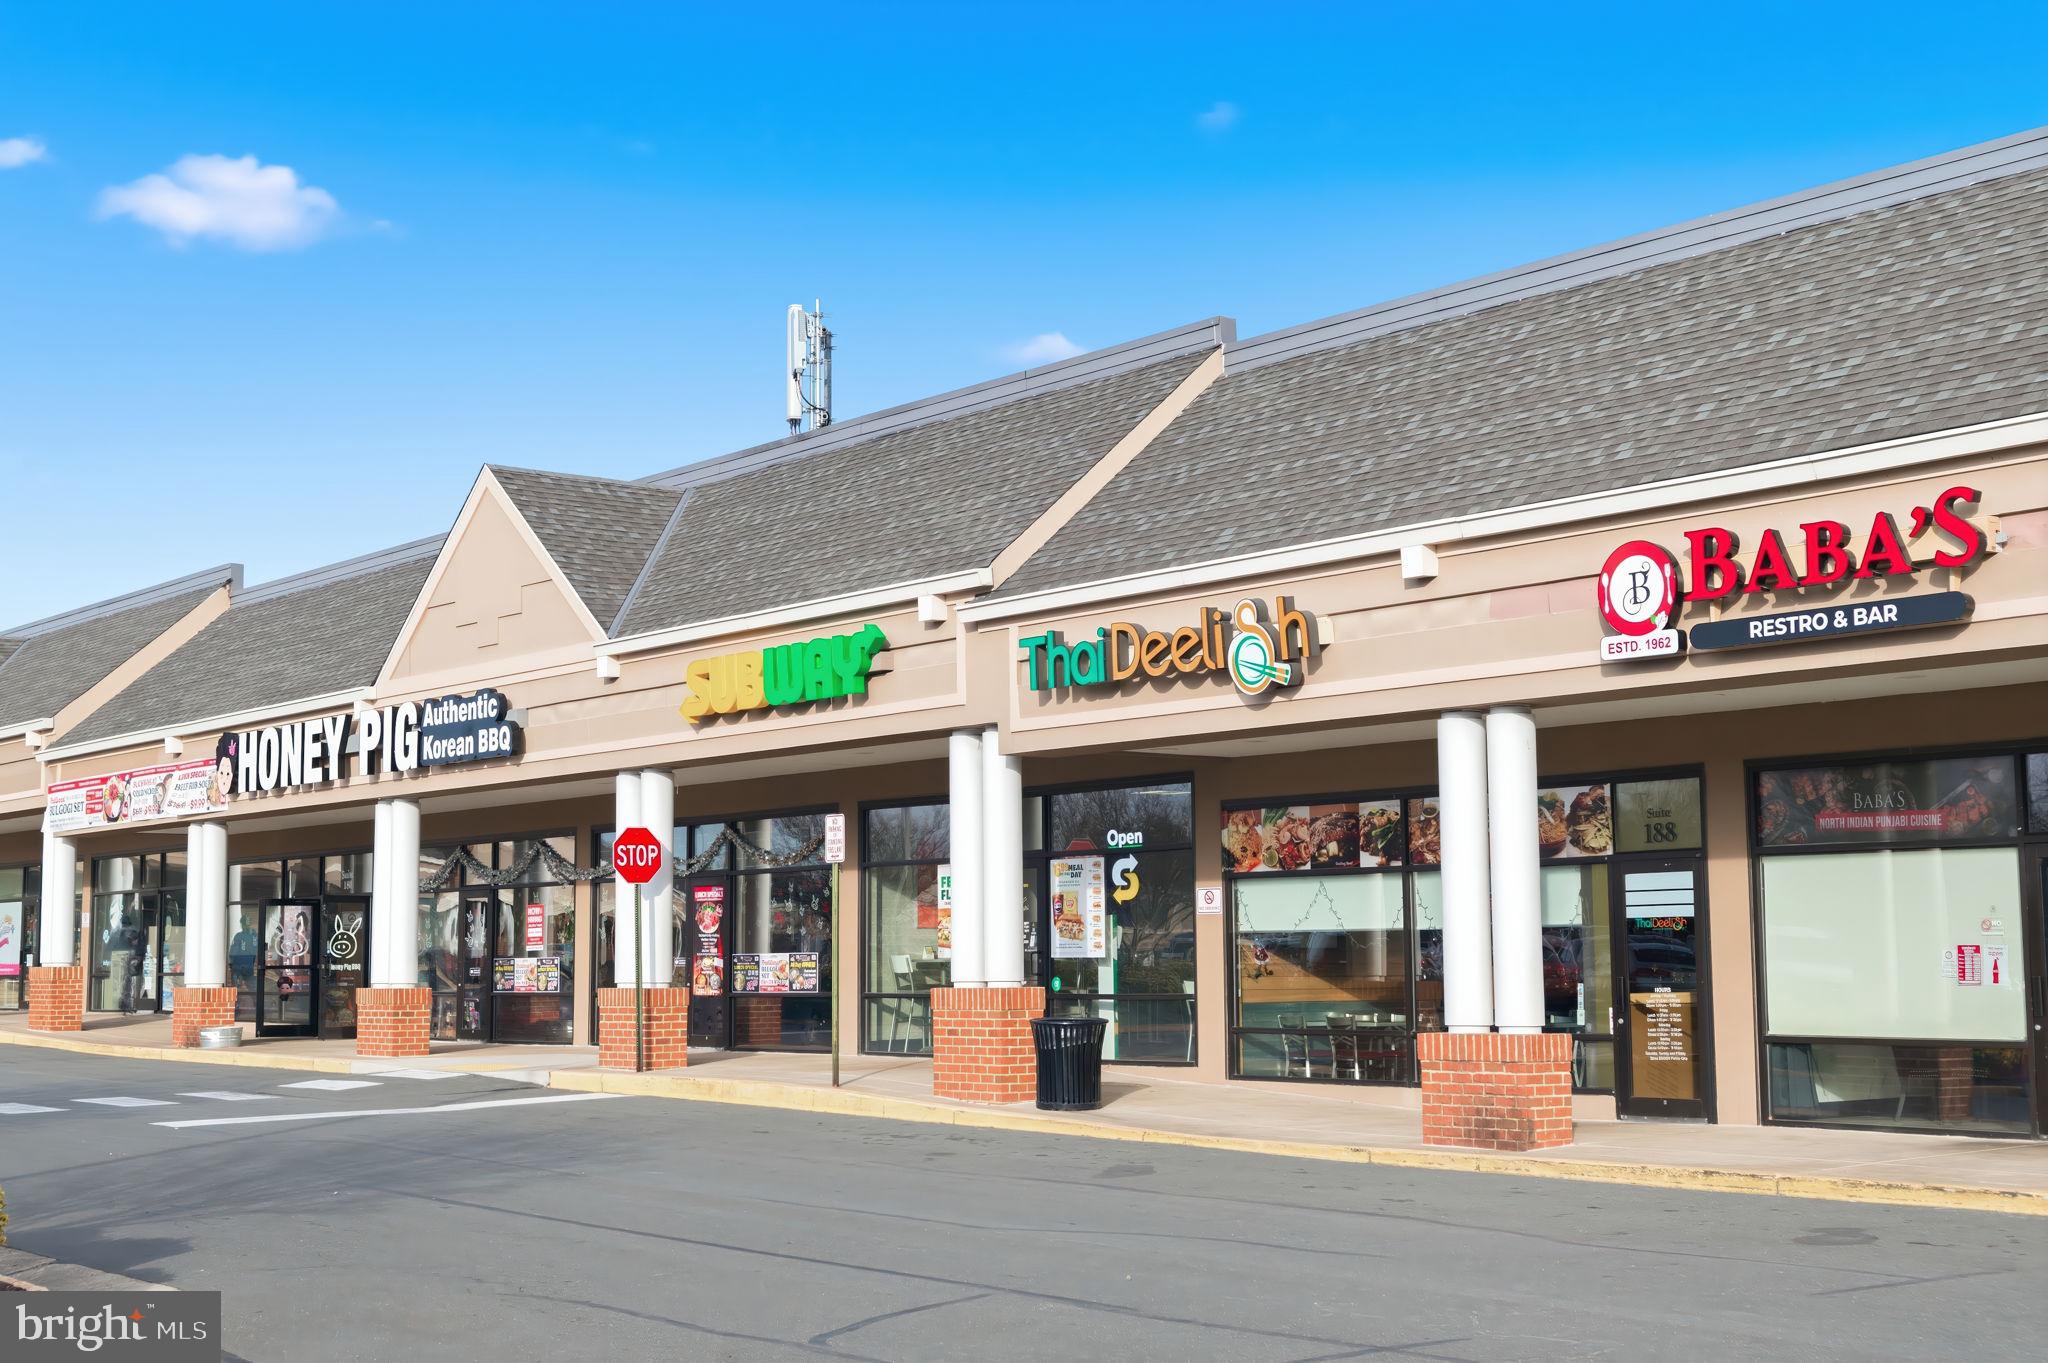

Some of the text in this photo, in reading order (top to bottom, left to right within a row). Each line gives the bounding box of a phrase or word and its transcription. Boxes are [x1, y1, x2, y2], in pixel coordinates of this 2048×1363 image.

[1683, 486, 1980, 602] BABA'S
[1749, 604, 1898, 639] RESTRO & BAR
[1608, 637, 1672, 655] ESTD. 1962
[679, 624, 886, 724] SUBWAY
[423, 694, 498, 727] Authentic
[237, 701, 418, 793] HONEY PIG
[423, 725, 511, 760] Korean BBQ
[1853, 790, 1905, 809] BABA'S
[1646, 808, 1672, 819] Suite
[1819, 814, 1942, 830] NORTH INDIAN PUNJABI CUISINE
[1107, 829, 1143, 848] Open
[1644, 822, 1678, 843] 188
[616, 844, 659, 867] STOP
